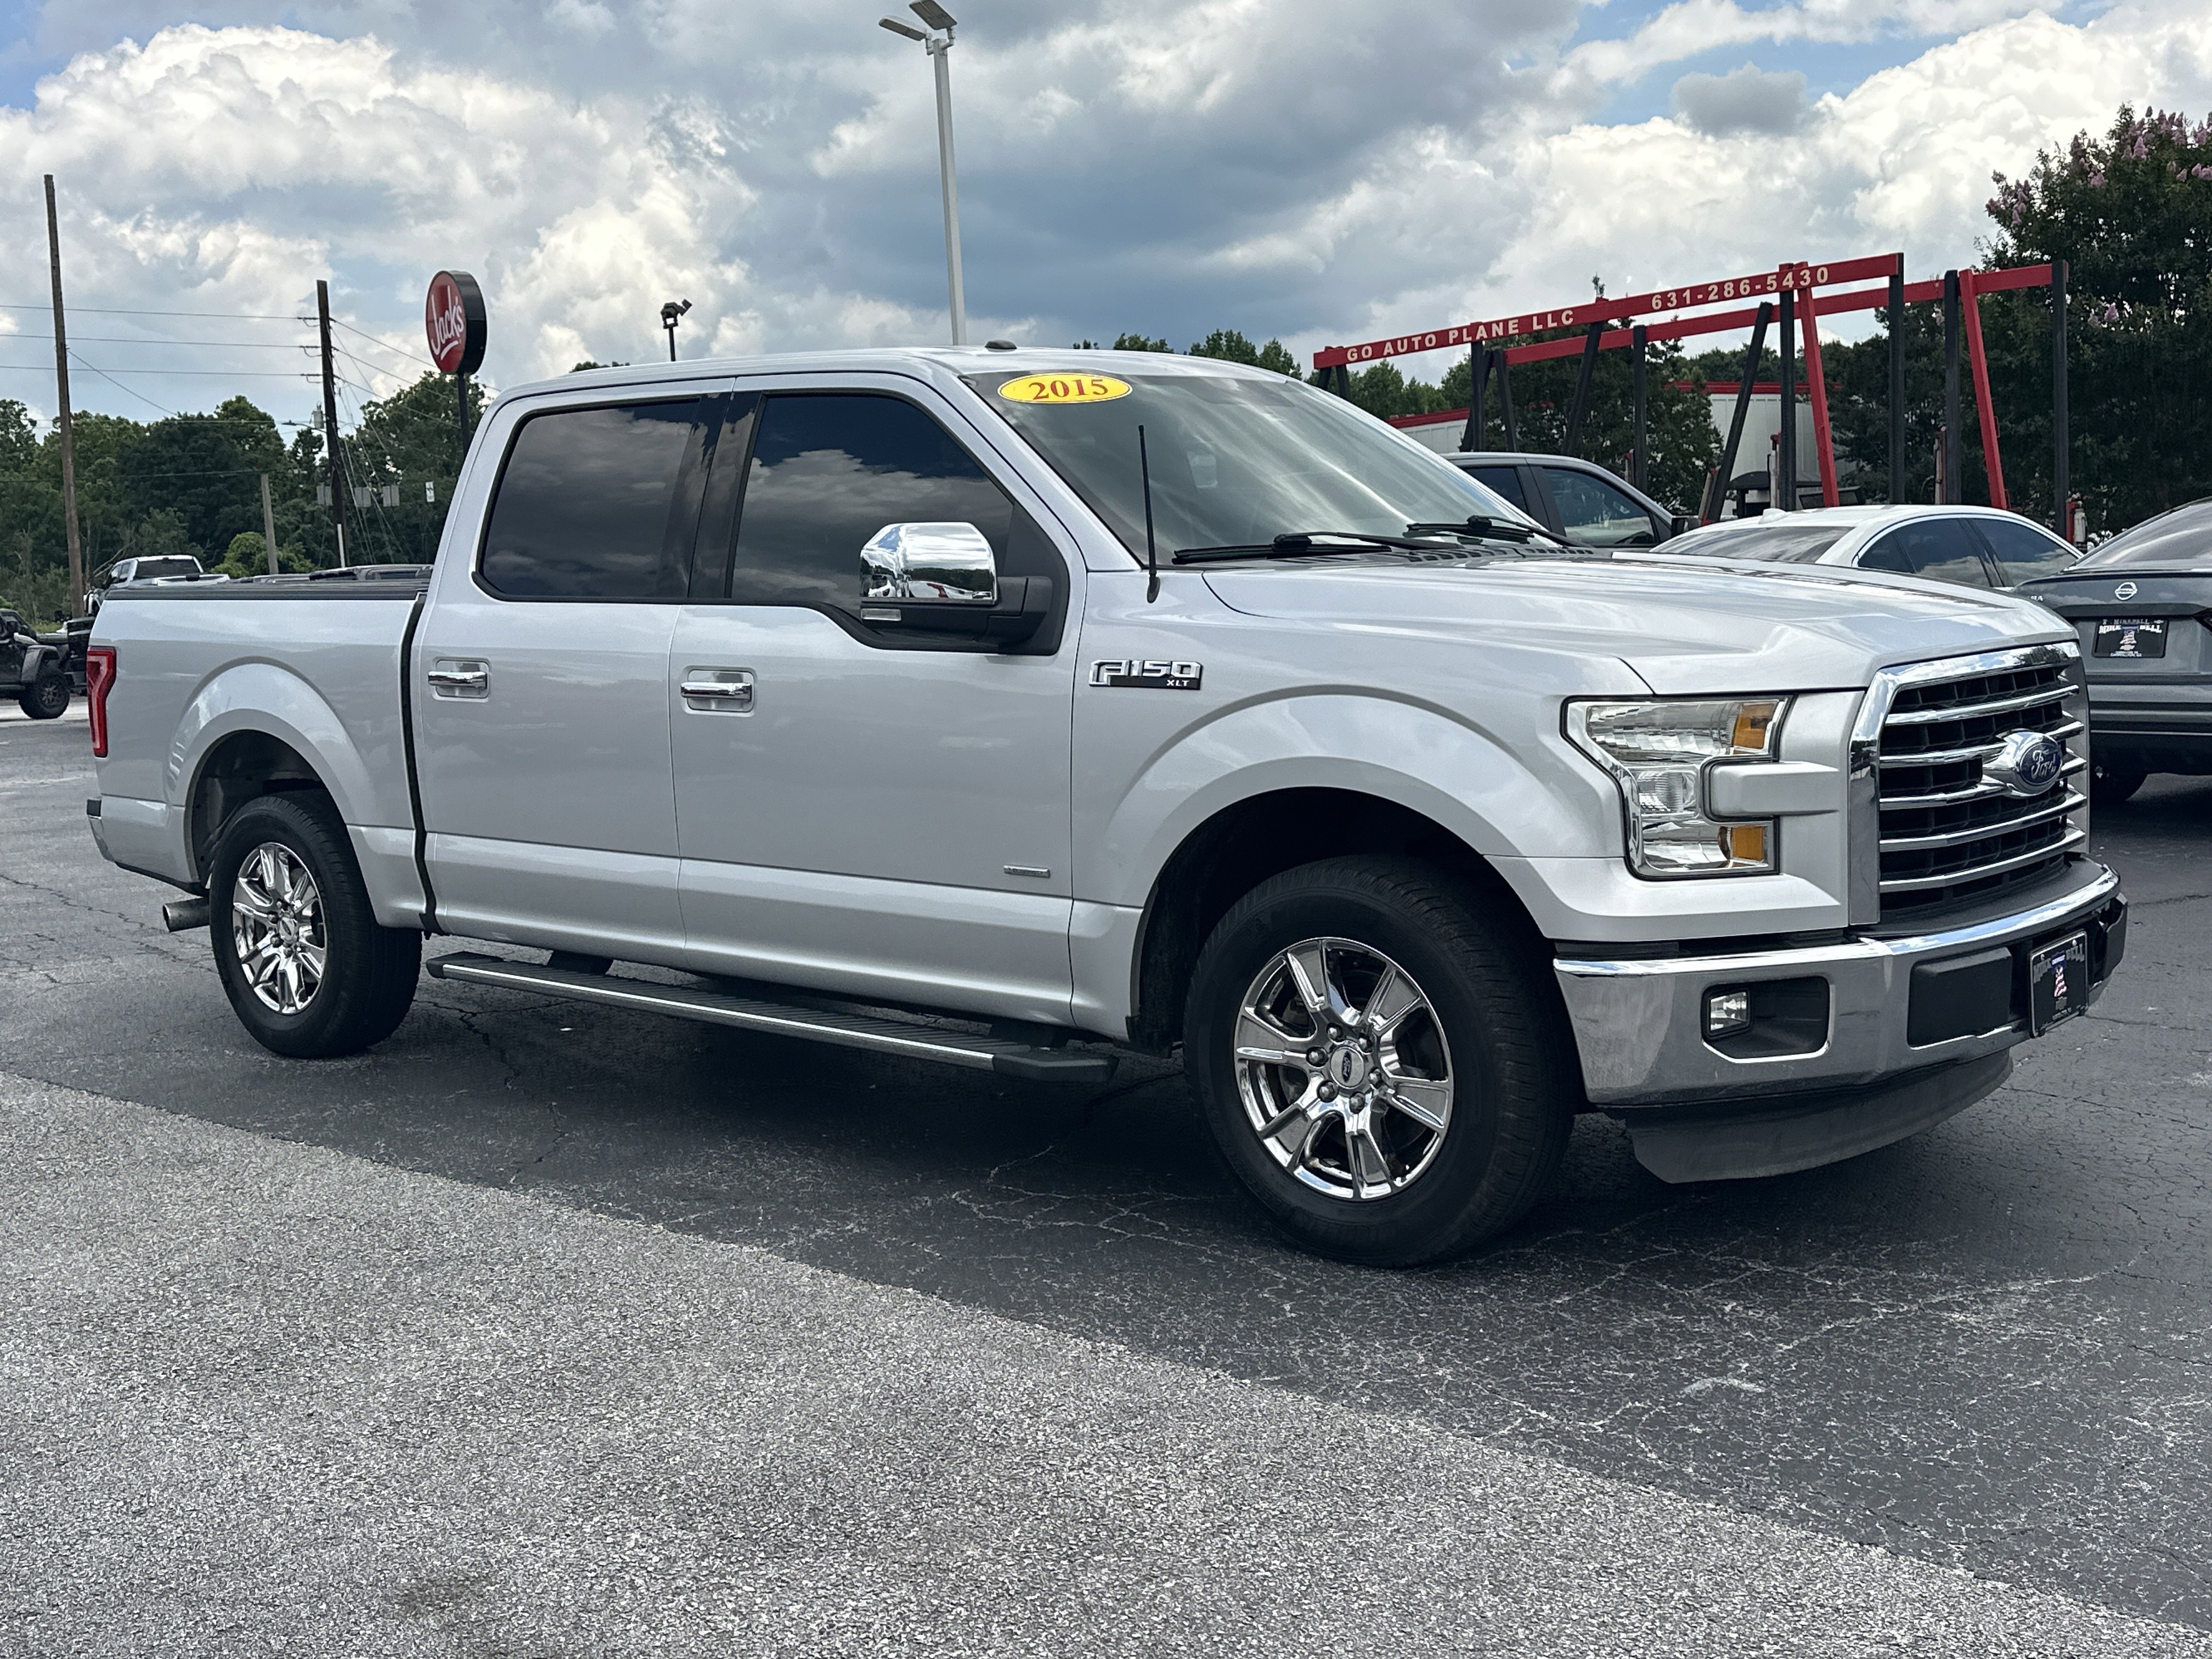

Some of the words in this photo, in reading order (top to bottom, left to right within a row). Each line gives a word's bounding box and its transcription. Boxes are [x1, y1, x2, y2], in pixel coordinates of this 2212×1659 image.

[431, 285, 465, 356] Jack's
[1346, 346, 1372, 362] GO
[1383, 334, 1437, 356] AUTO
[1449, 319, 1519, 345] PLANE
[1532, 309, 1574, 330] LLC
[1651, 266, 1829, 311] 631-286-5430
[1028, 379, 1108, 400] 2015
[2030, 749, 2057, 780] Ford
